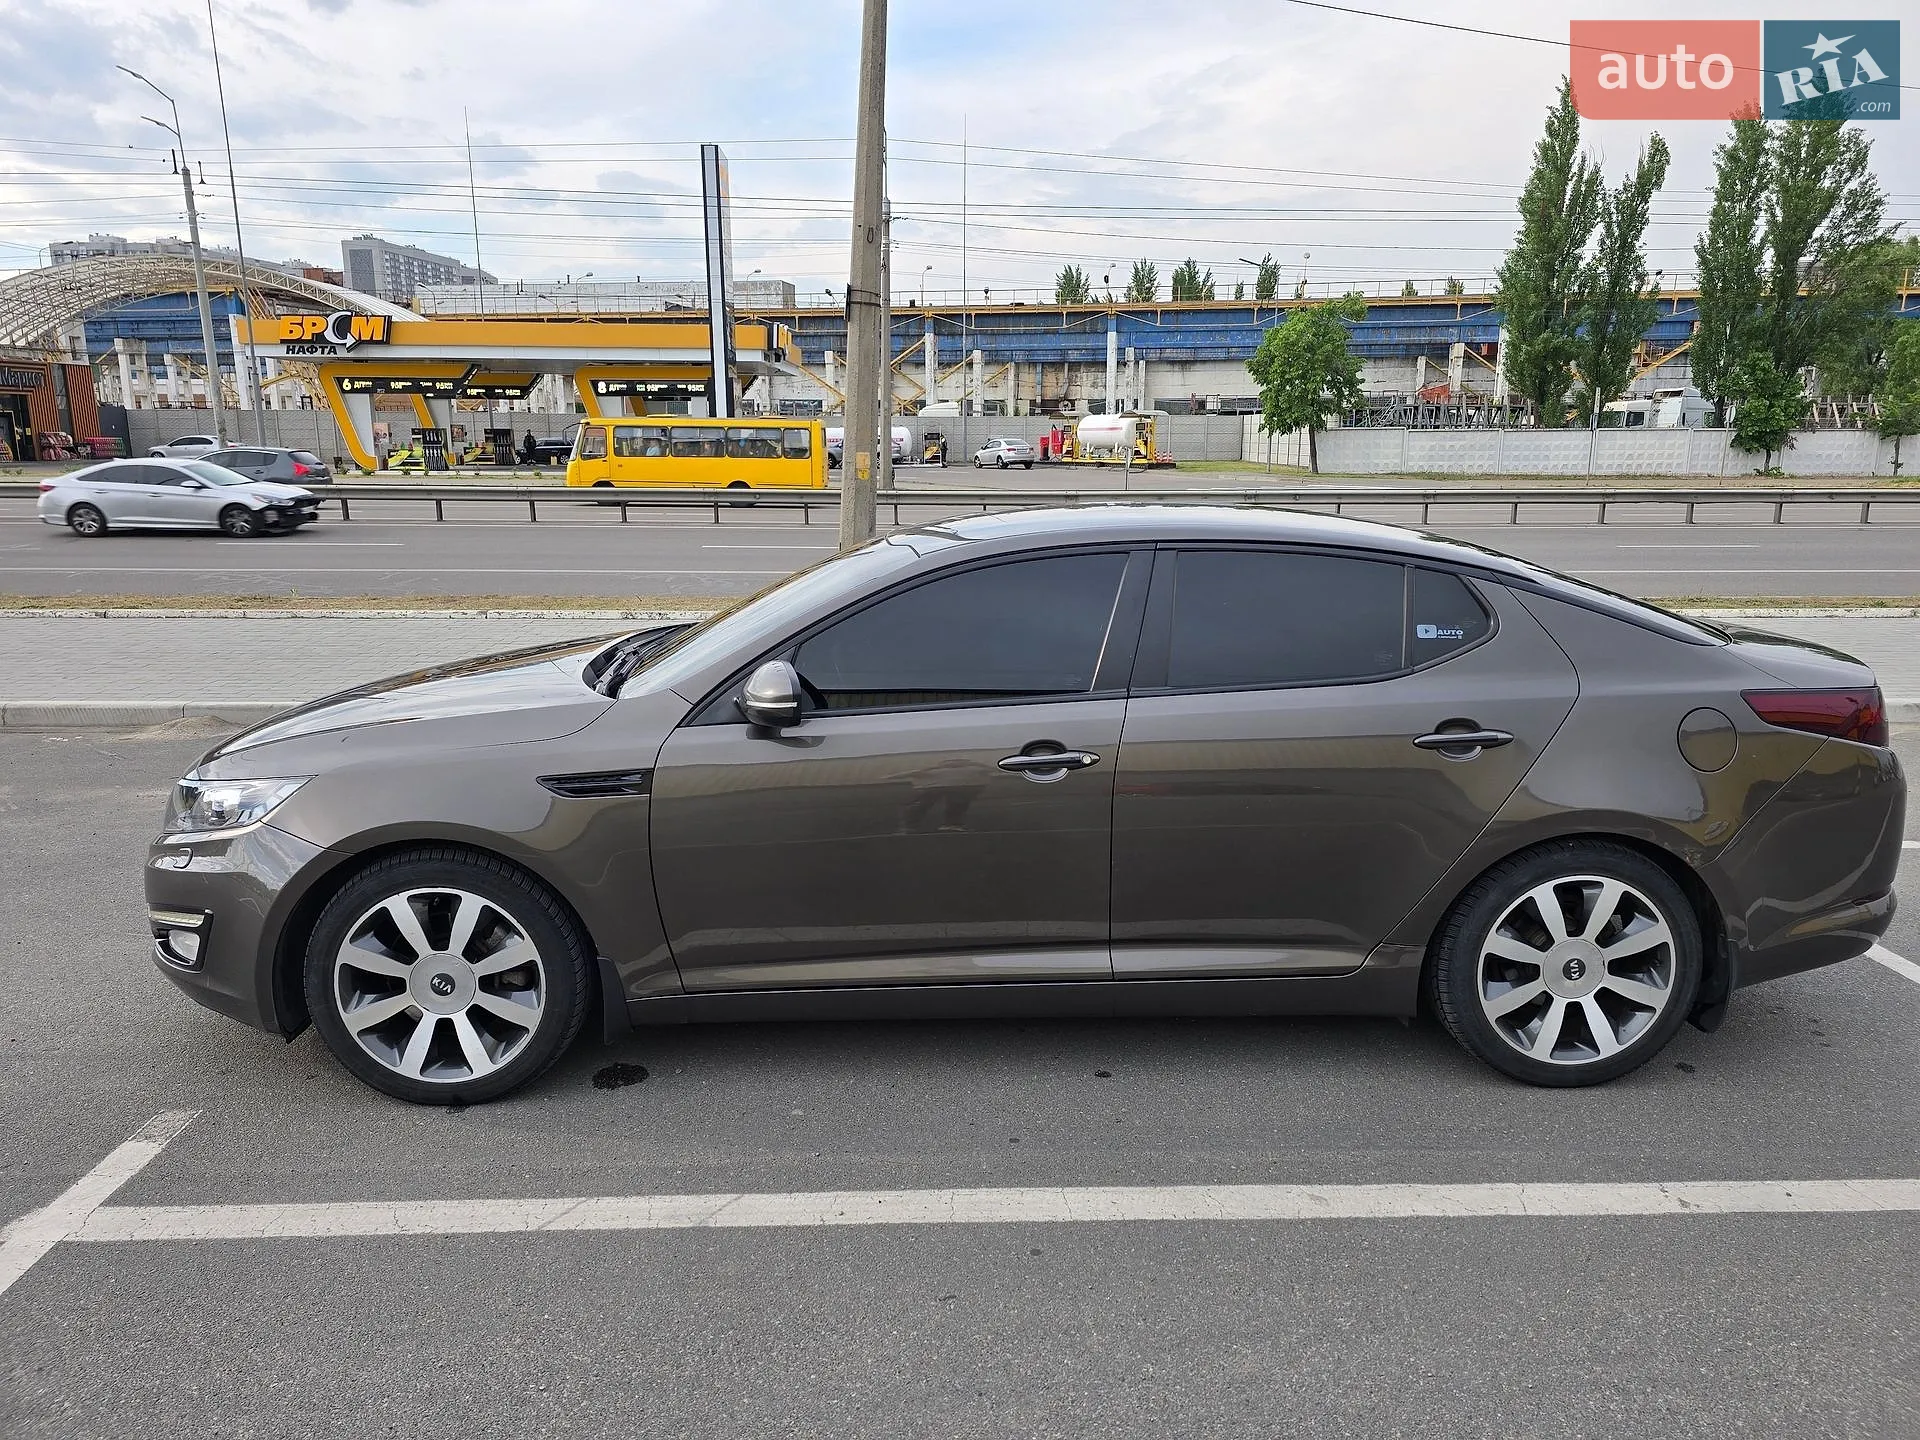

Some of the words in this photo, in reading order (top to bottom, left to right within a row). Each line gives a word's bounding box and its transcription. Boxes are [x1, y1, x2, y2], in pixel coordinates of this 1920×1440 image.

[280, 310, 385, 351] БРСМ
[286, 345, 337, 355] НАФТА
[1570, 960, 1580, 980] KIA
[432, 976, 452, 993] KIA
